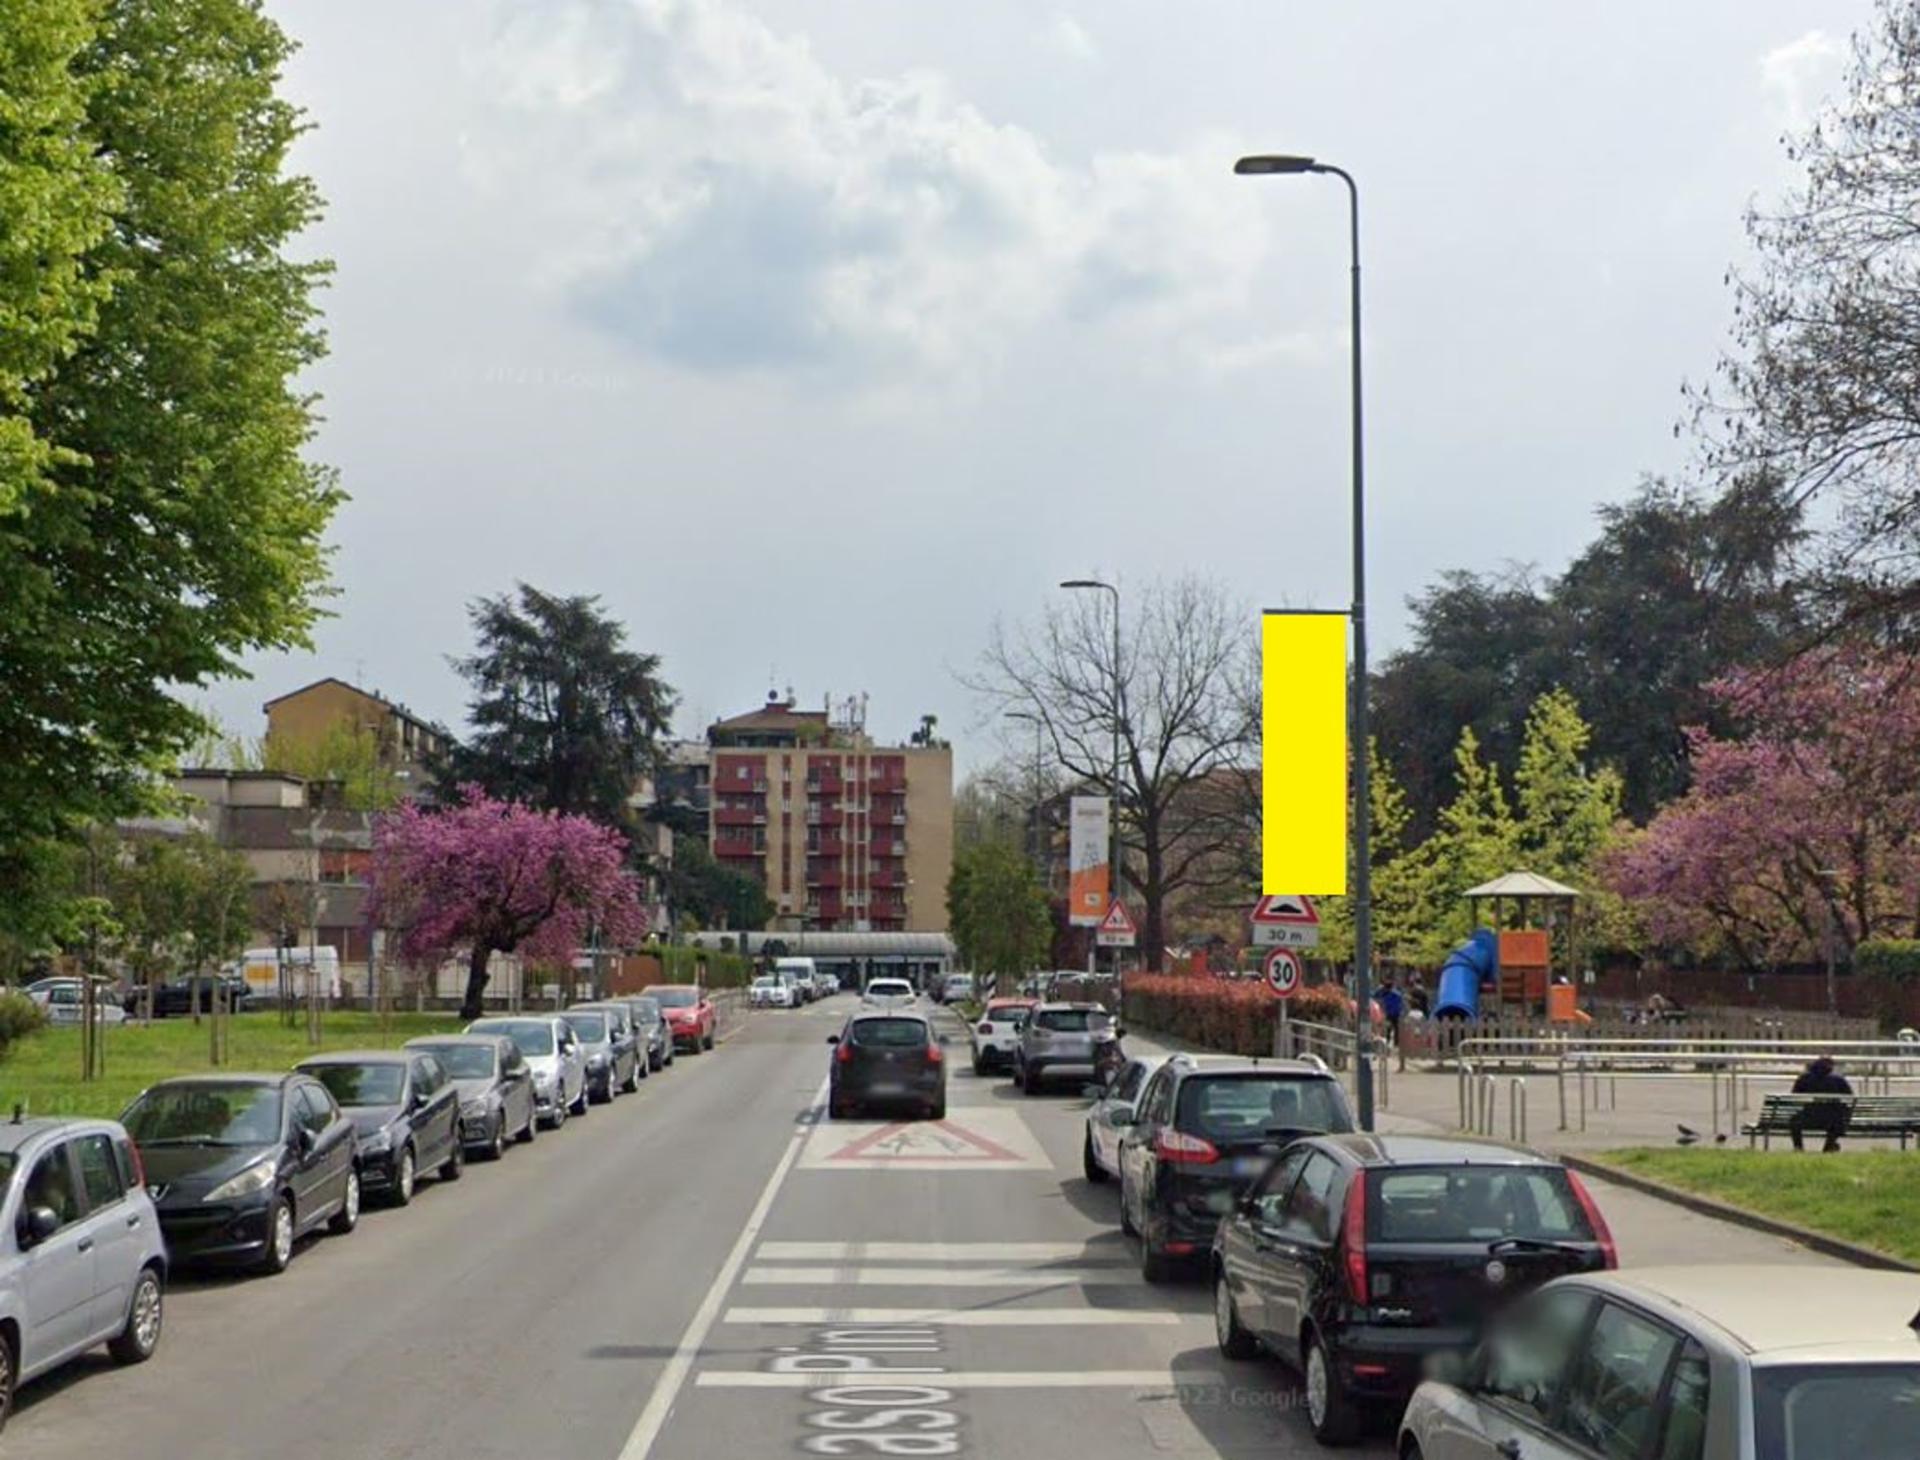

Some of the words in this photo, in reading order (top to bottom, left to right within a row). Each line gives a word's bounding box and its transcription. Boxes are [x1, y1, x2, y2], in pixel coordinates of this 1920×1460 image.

[1268, 928, 1286, 941] 30
[1290, 932, 1303, 942] m
[1272, 960, 1293, 984] 30
